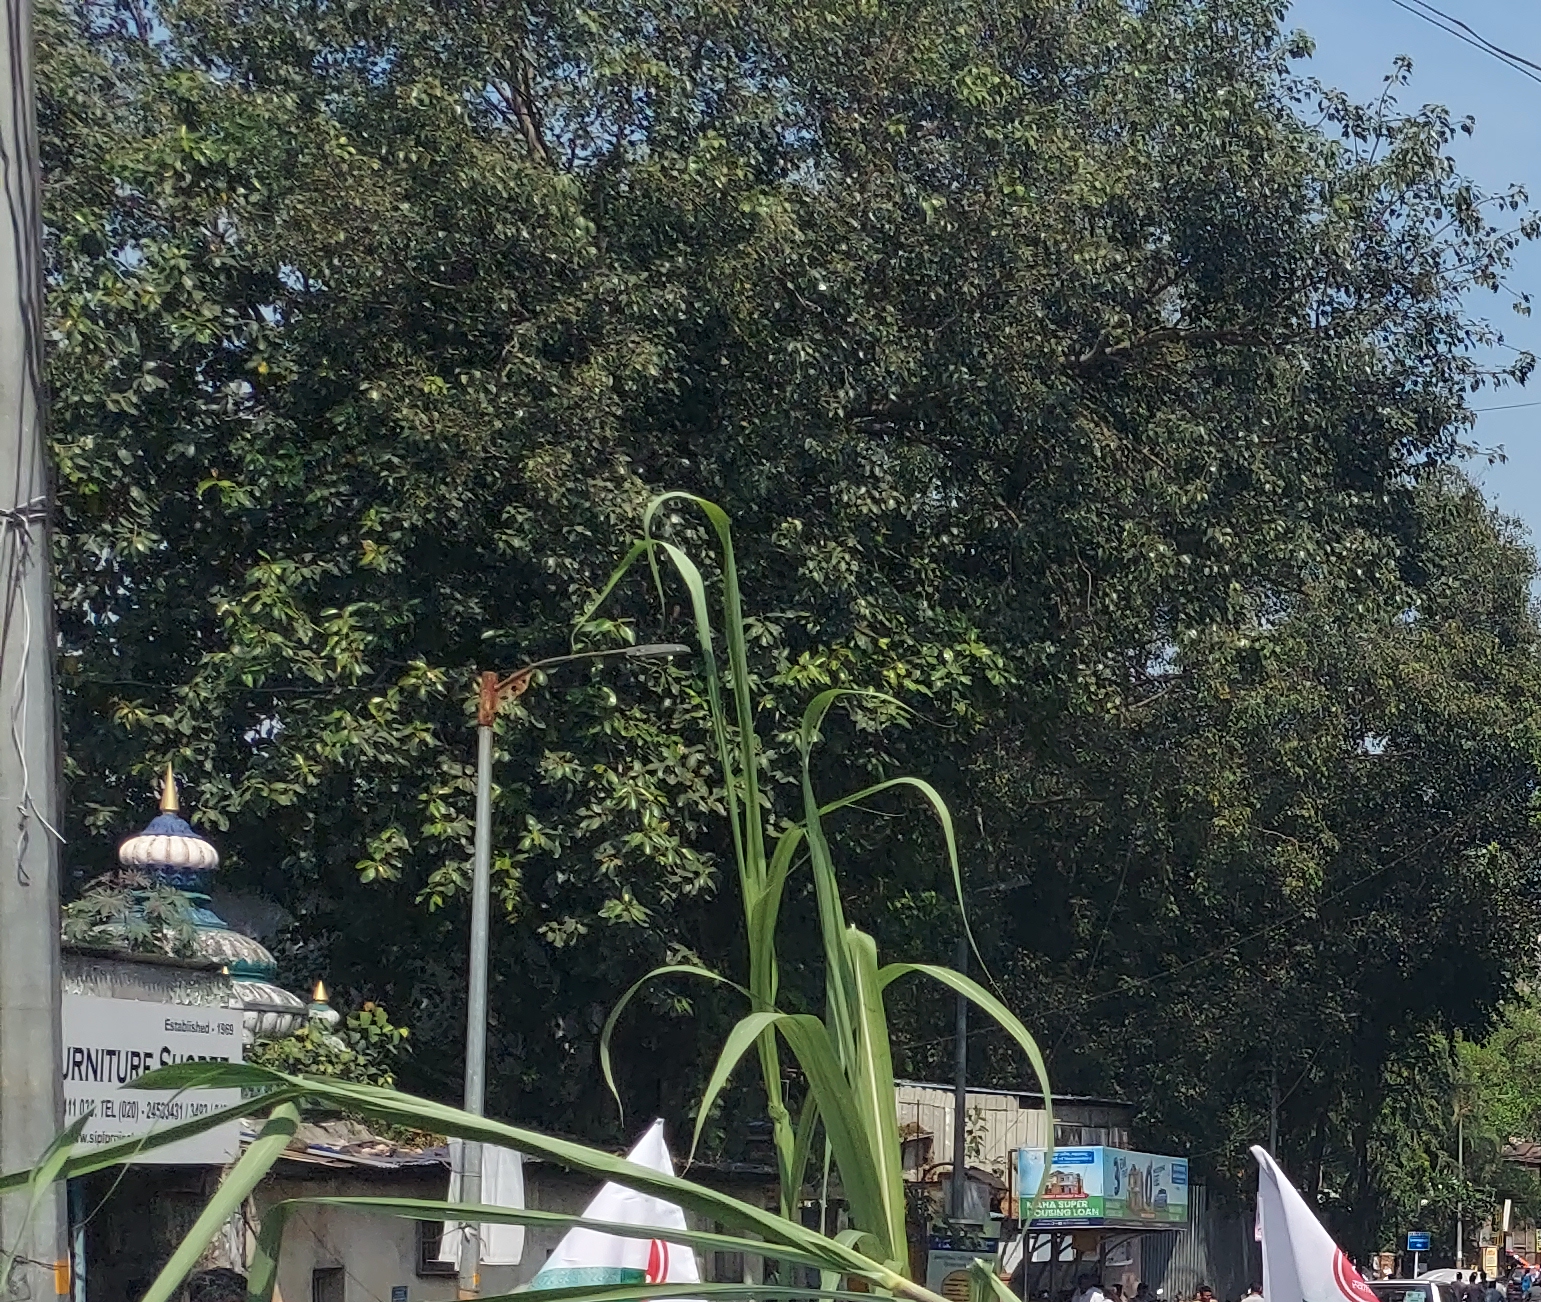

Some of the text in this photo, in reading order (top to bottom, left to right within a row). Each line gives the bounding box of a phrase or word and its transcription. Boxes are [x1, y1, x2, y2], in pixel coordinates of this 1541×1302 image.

[164, 1018, 210, 1034] Established
[216, 1022, 234, 1036] 1969
[100, 1099, 117, 1118] TEL
[118, 1100, 139, 1122] (020)
[1058, 1200, 1089, 1209] SUPER
[1027, 1208, 1100, 1217] OUSING LOAN
